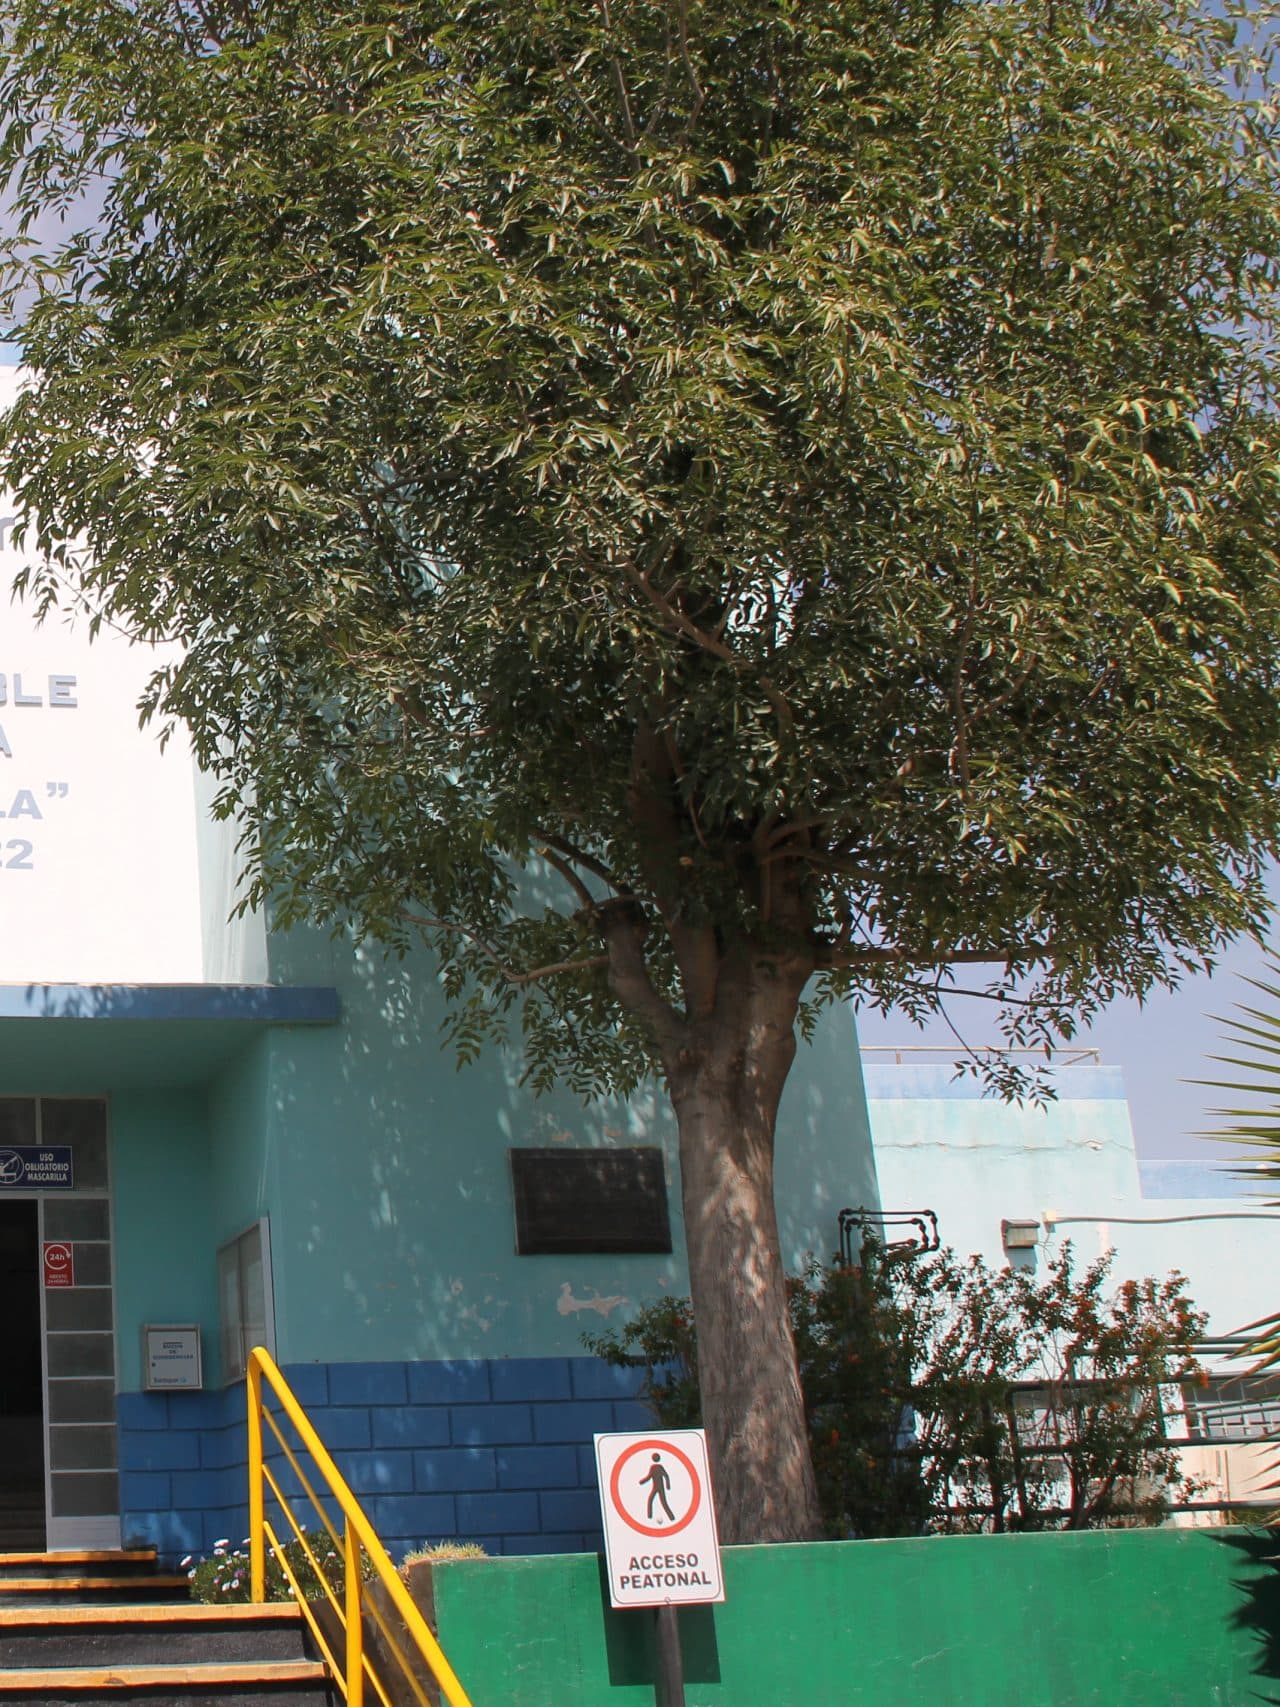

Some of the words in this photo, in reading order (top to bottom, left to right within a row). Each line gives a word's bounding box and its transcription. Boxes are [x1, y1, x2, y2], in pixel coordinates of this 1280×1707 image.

[39, 1153, 54, 1162] USO
[24, 1162, 70, 1172] OBLIGATORIO
[27, 1172, 68, 1182] MASCARILLA
[50, 1253, 65, 1261] 24h
[628, 1553, 699, 1571] ACCESO
[620, 1571, 712, 1589] PEATONAL
